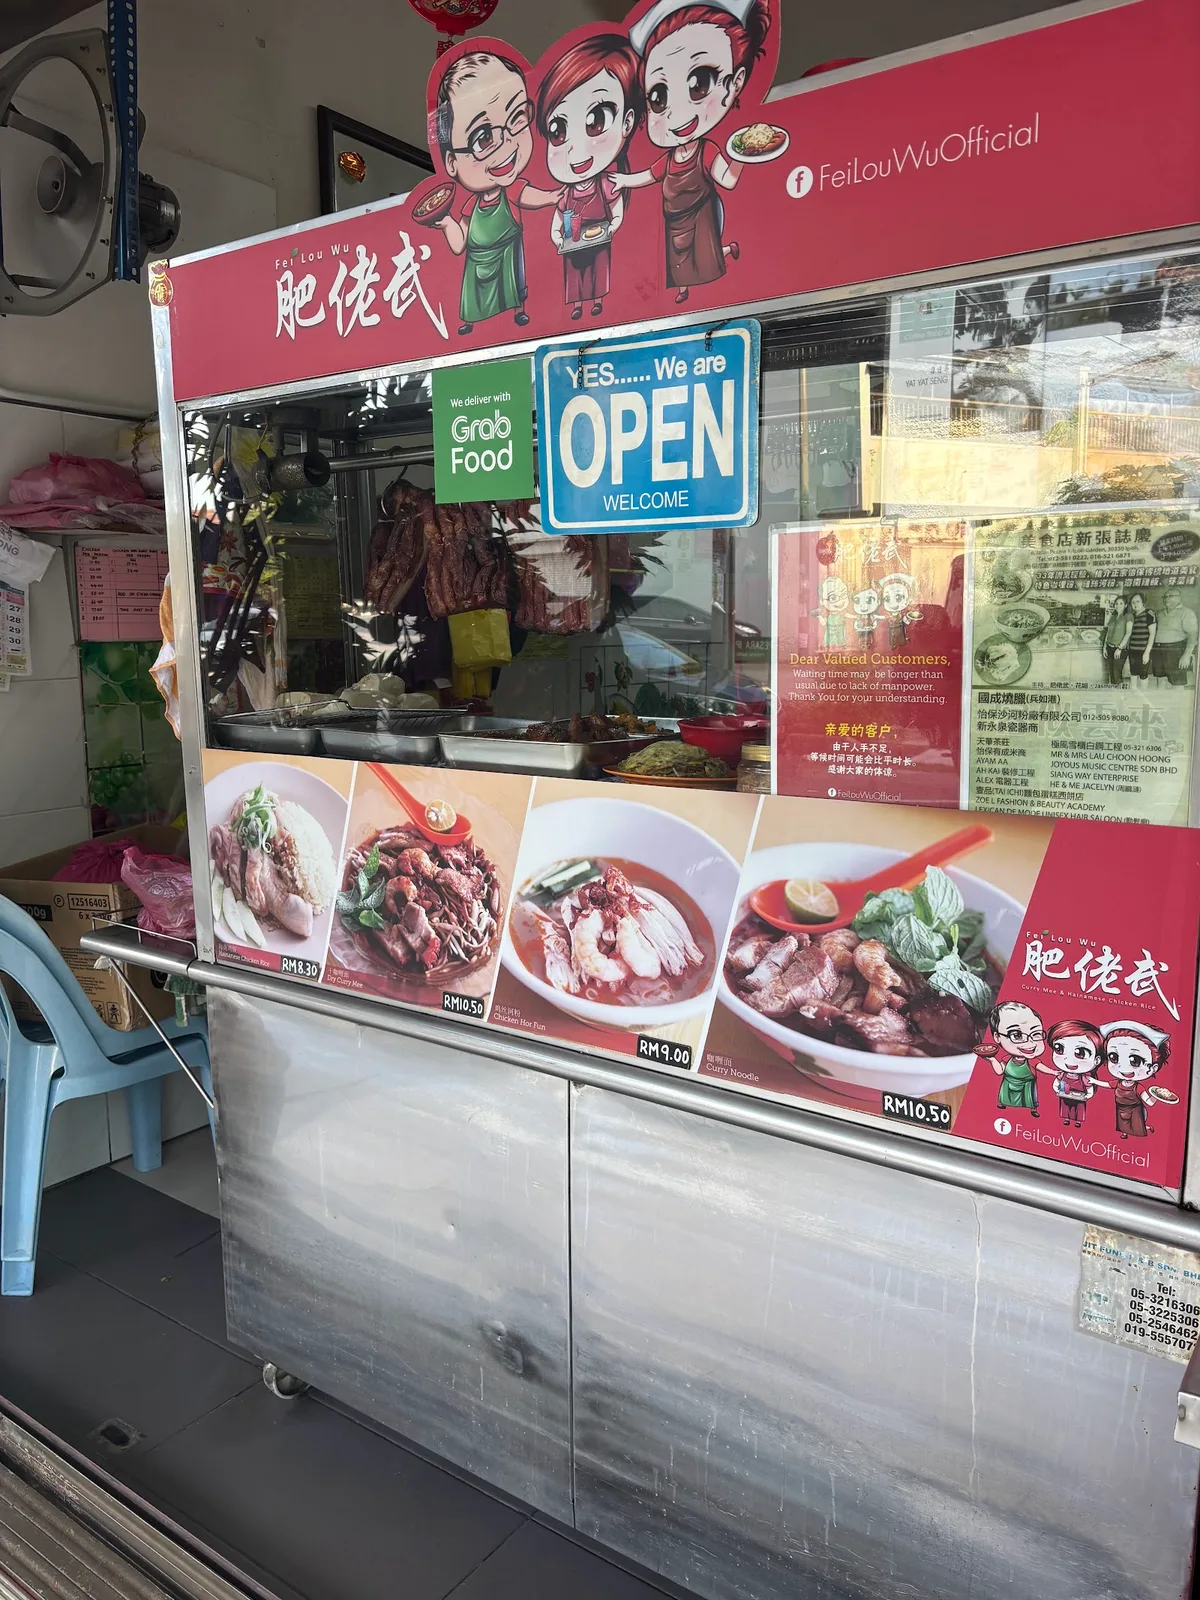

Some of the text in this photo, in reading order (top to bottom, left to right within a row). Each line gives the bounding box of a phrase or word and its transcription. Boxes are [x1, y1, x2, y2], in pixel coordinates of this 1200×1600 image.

[820, 112, 1039, 191] FeiLouWuOfficial
[275, 243, 349, 270] Fei Lou Wu
[275, 230, 449, 340] 肥佬武
[654, 356, 688, 381] We
[693, 354, 727, 376] are
[450, 391, 511, 408] We deliver with
[451, 409, 512, 443] Grab
[559, 379, 735, 488] OPEN
[451, 440, 513, 474] Food
[603, 490, 689, 512] WELCOME
[9, 604, 21, 613] 27
[9, 615, 21, 624] 28
[9, 626, 21, 634] 29
[9, 636, 21, 645] 30
[789, 653, 951, 667] Dear Valued Customers,
[793, 669, 943, 681] Waiting time may be longer than
[795, 681, 935, 692] usual due to lack of manpower.
[788, 691, 948, 705] Thank You for your understanding.
[1071, 751, 1088, 759] MRS
[1090, 752, 1105, 760] LAU
[1107, 753, 1137, 762] CHOON
[1139, 755, 1171, 763] HOONG
[988, 767, 1000, 775] KAI
[1050, 761, 1178, 774] JOYOUS MUSIC CENTRE SDN BHD
[1050, 770, 1139, 782] SIANG WAY ENTERPRISE
[976, 776, 994, 784] ALEX
[1069, 782, 1081, 790] ME
[1082, 783, 1115, 791] JACELYN
[976, 796, 990, 804] ZOE
[997, 798, 1028, 807] FASHION
[1036, 801, 1066, 809] BEAUTY
[1067, 802, 1106, 812] ACADEMY
[71, 897, 107, 908] 12516403
[1026, 931, 1097, 947] Fei Lou Wu
[282, 957, 318, 977] RM8.30
[327, 974, 364, 989] Dry Curry Mee
[1021, 940, 1181, 1021] 肥佬武
[444, 994, 483, 1015] RM10.50
[1021, 984, 1040, 992] Curry
[1042, 987, 1057, 995] Mee
[1108, 997, 1138, 1008] Chicken
[1140, 1003, 1157, 1011] Rice
[493, 1012, 546, 1031] Chicken Hor Fun
[639, 1039, 690, 1065] RM9.00
[706, 1063, 760, 1082] Curry Noodle
[884, 1093, 950, 1124] RM10.50
[1015, 1124, 1150, 1168] FeiLouWuOfficial
[1083, 1241, 1098, 1250] JIT
[1157, 1282, 1176, 1297] Tel:
[1131, 1287, 1200, 1316] 05-3216306
[1130, 1300, 1199, 1328] 05-3225306
[1129, 1312, 1198, 1341] 05-2546462
[1124, 1323, 1196, 1351] 019-555707
